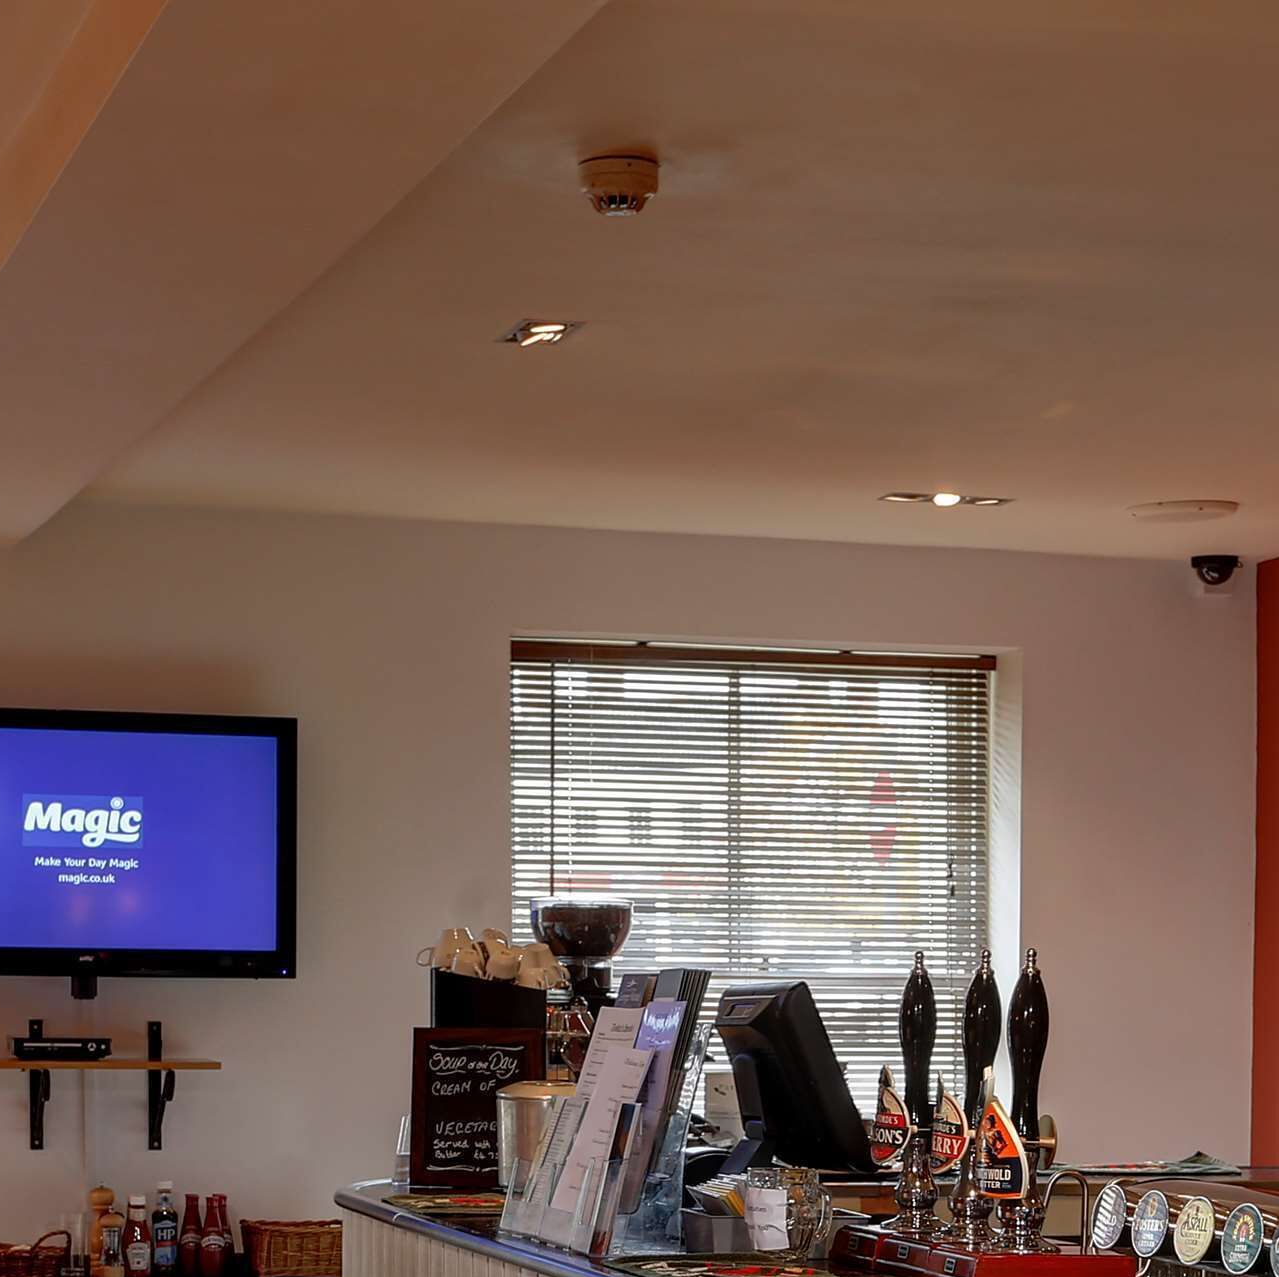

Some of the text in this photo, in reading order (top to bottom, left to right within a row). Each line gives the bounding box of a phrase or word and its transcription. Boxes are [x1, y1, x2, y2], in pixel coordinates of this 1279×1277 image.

[23, 796, 142, 848] Magic
[34, 857, 139, 870] Make Your Day Magic
[58, 874, 115, 885] magic.co.uk
[431, 1079, 496, 1096] CREAM OF
[875, 1128, 904, 1145] SON'S
[932, 1135, 962, 1155] ERRY
[157, 1228, 176, 1240] HP
